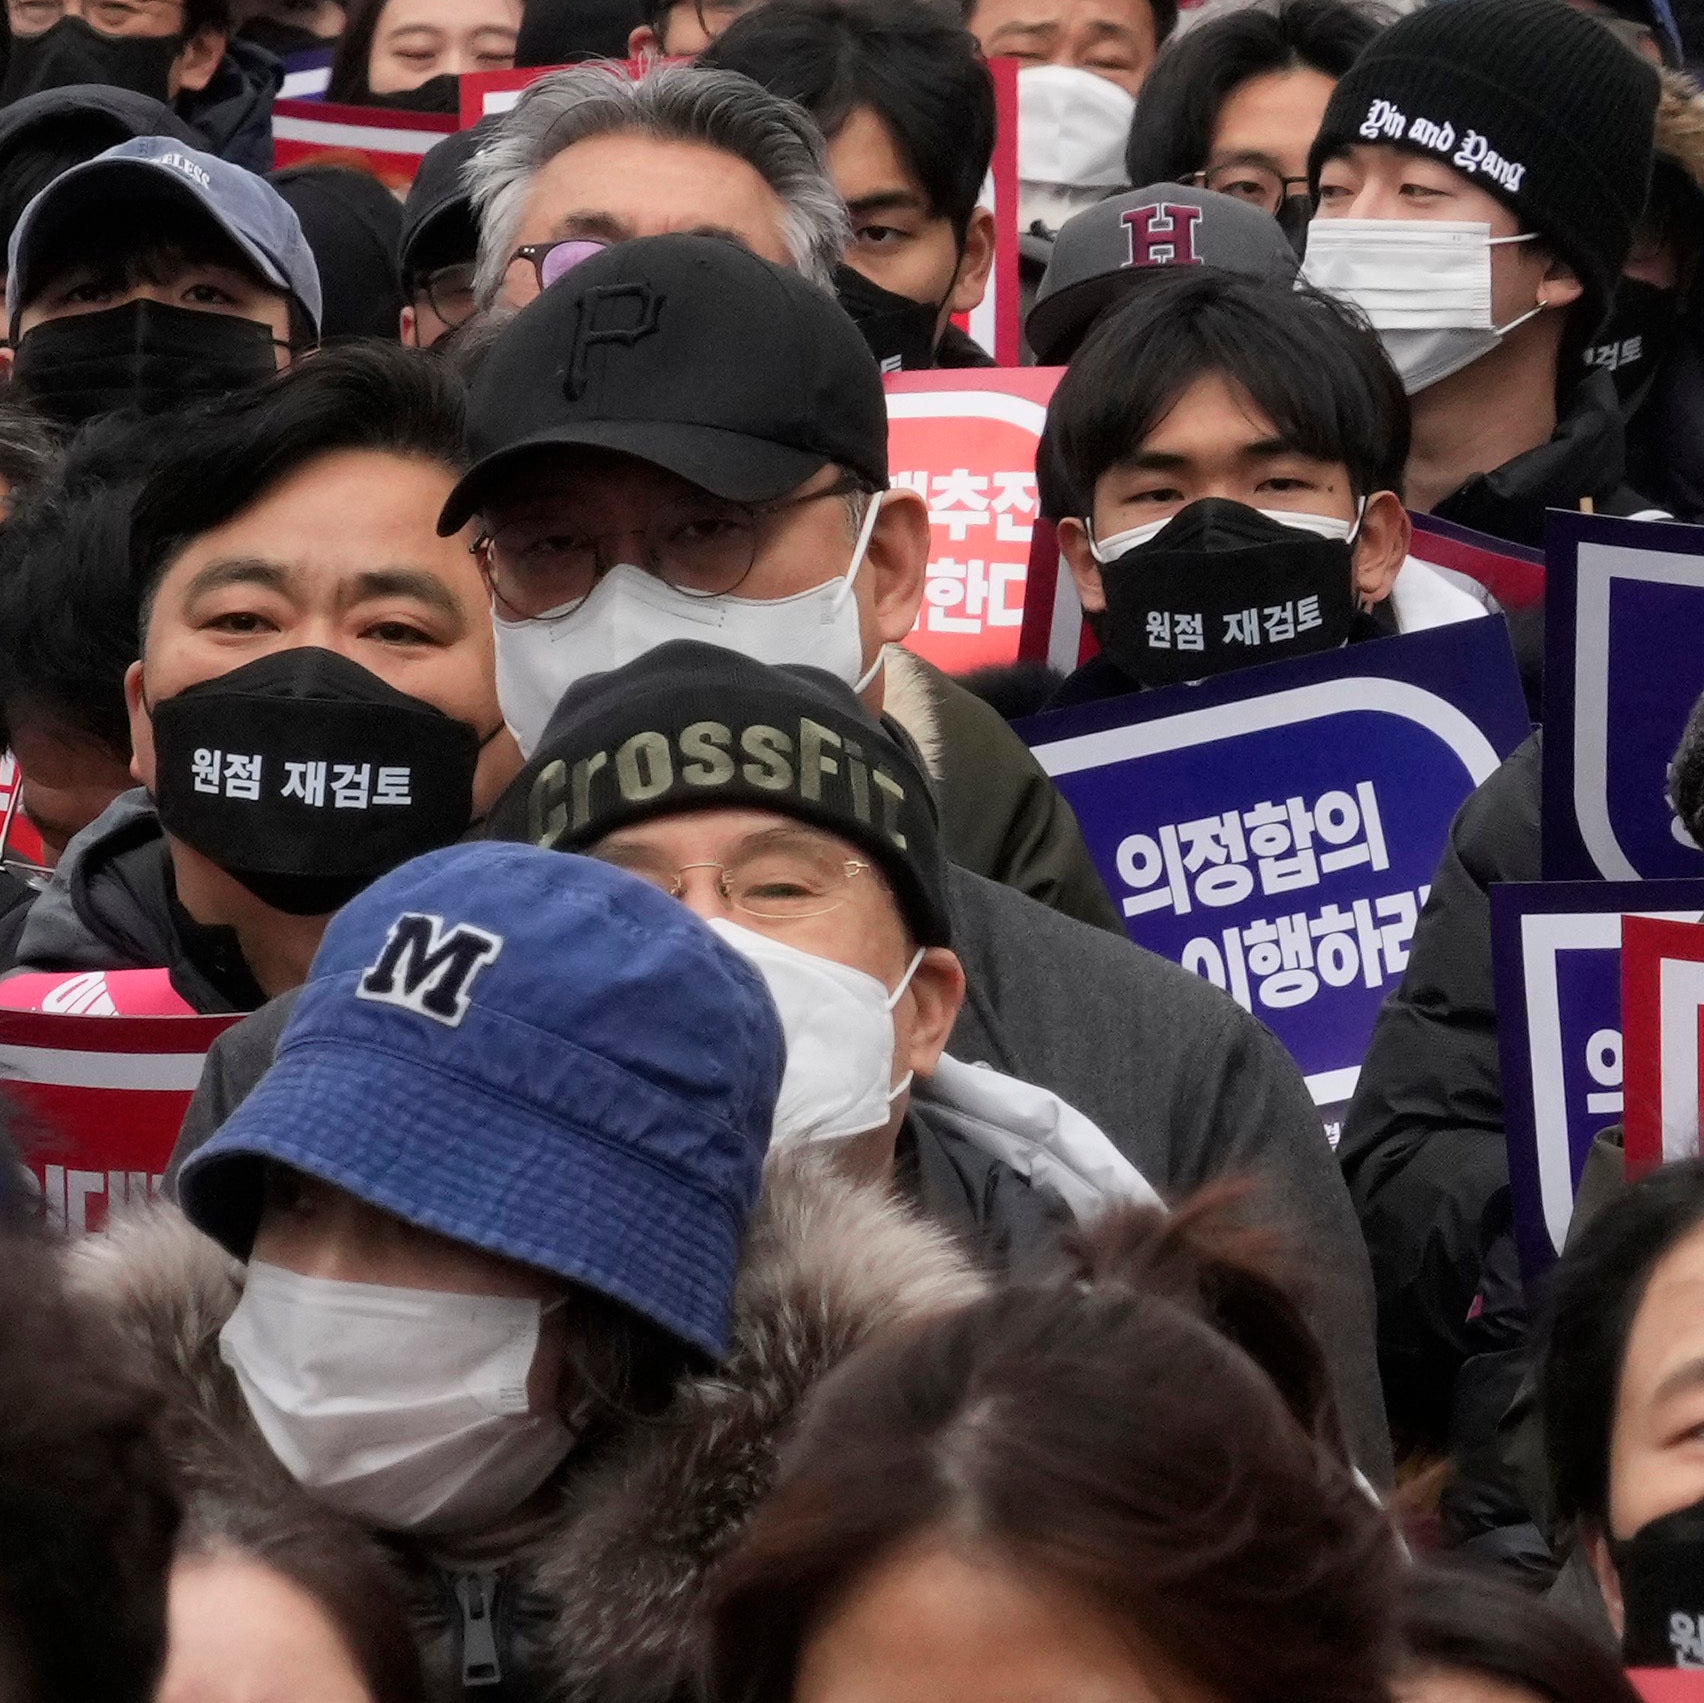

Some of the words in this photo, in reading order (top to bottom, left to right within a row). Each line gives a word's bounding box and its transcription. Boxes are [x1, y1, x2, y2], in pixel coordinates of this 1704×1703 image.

[1359, 98, 1402, 138] Yin
[1407, 114, 1455, 153] and
[1453, 127, 1526, 192] Yang
[1121, 201, 1205, 267] H
[563, 282, 667, 401] P
[1144, 611, 1204, 654] 원점
[1223, 595, 1324, 648] 재검토
[191, 747, 262, 802] 원점
[280, 761, 413, 809] 재검토
[1115, 781, 1390, 918] 의정합의
[364, 914, 496, 1024] M
